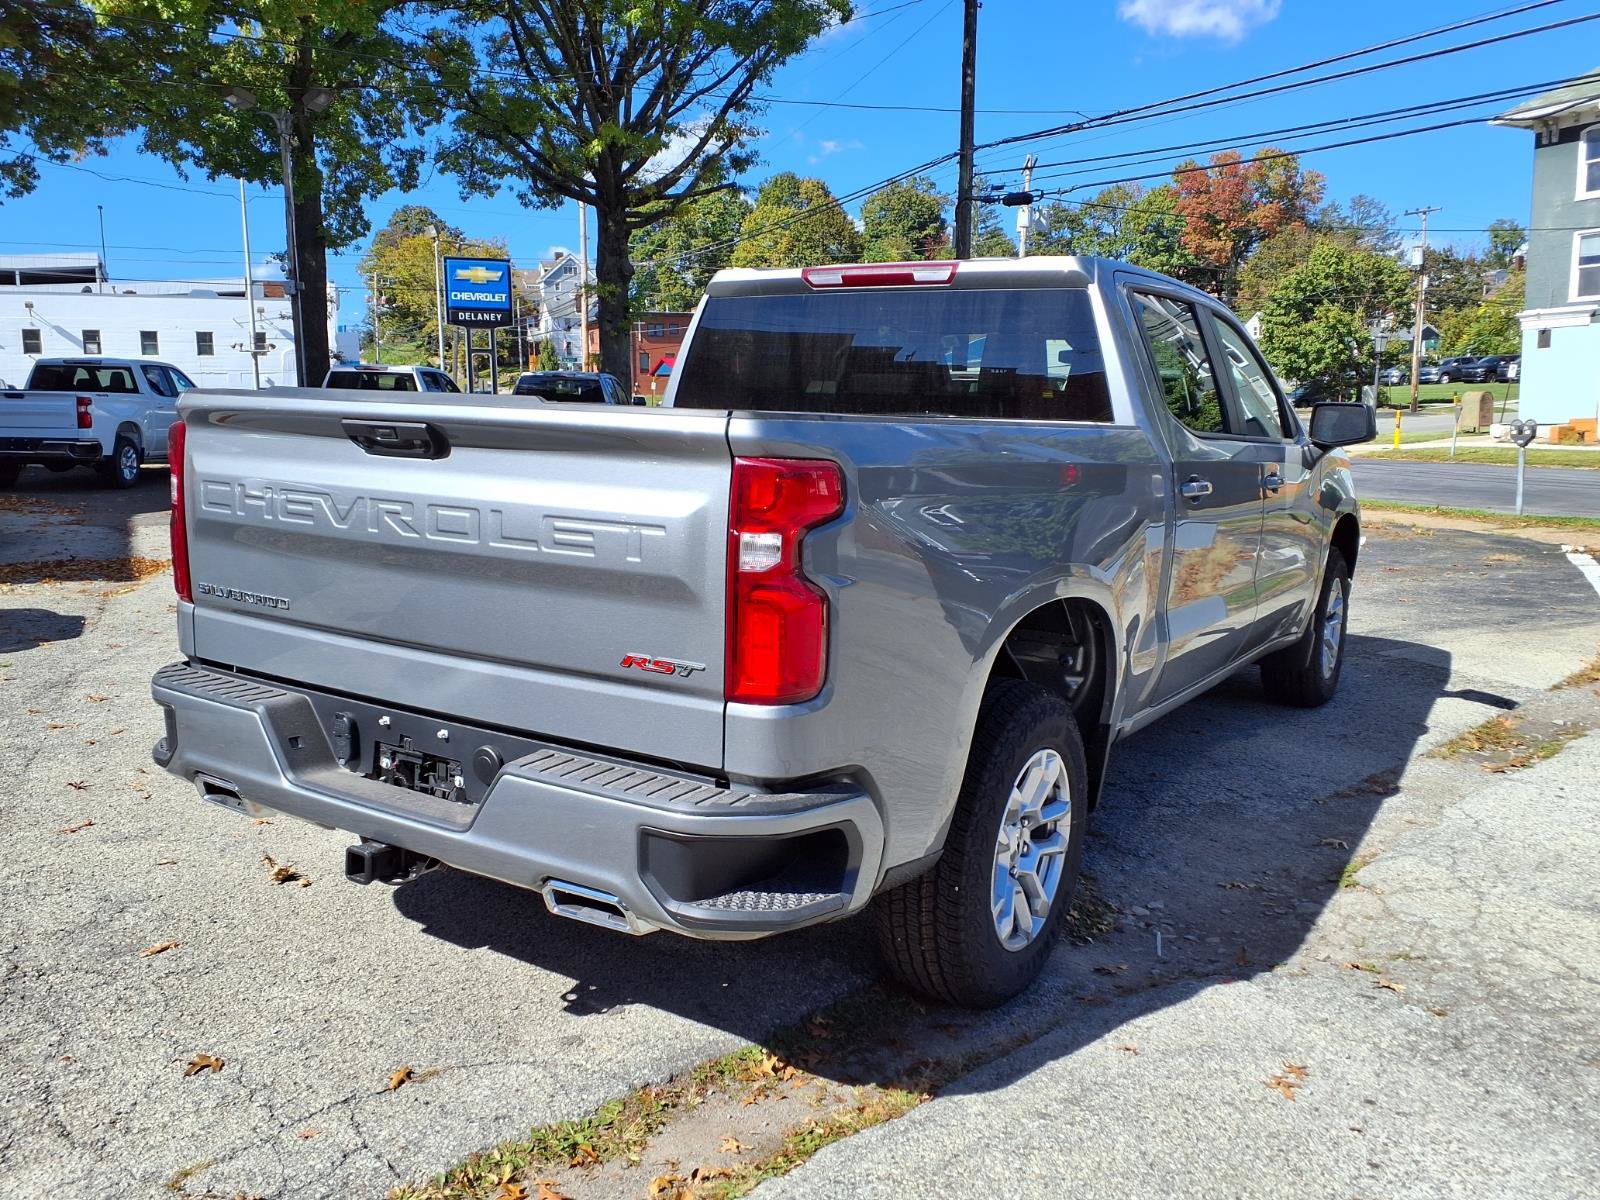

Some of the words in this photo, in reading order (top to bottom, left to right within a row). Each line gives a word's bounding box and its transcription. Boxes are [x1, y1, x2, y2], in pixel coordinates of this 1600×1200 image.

[451, 291, 507, 302] CHEVROLET
[458, 312, 502, 321] DELANEY
[200, 479, 667, 562] CHEVROLET
[198, 582, 290, 610] SILVERADO
[620, 652, 706, 678] RST
